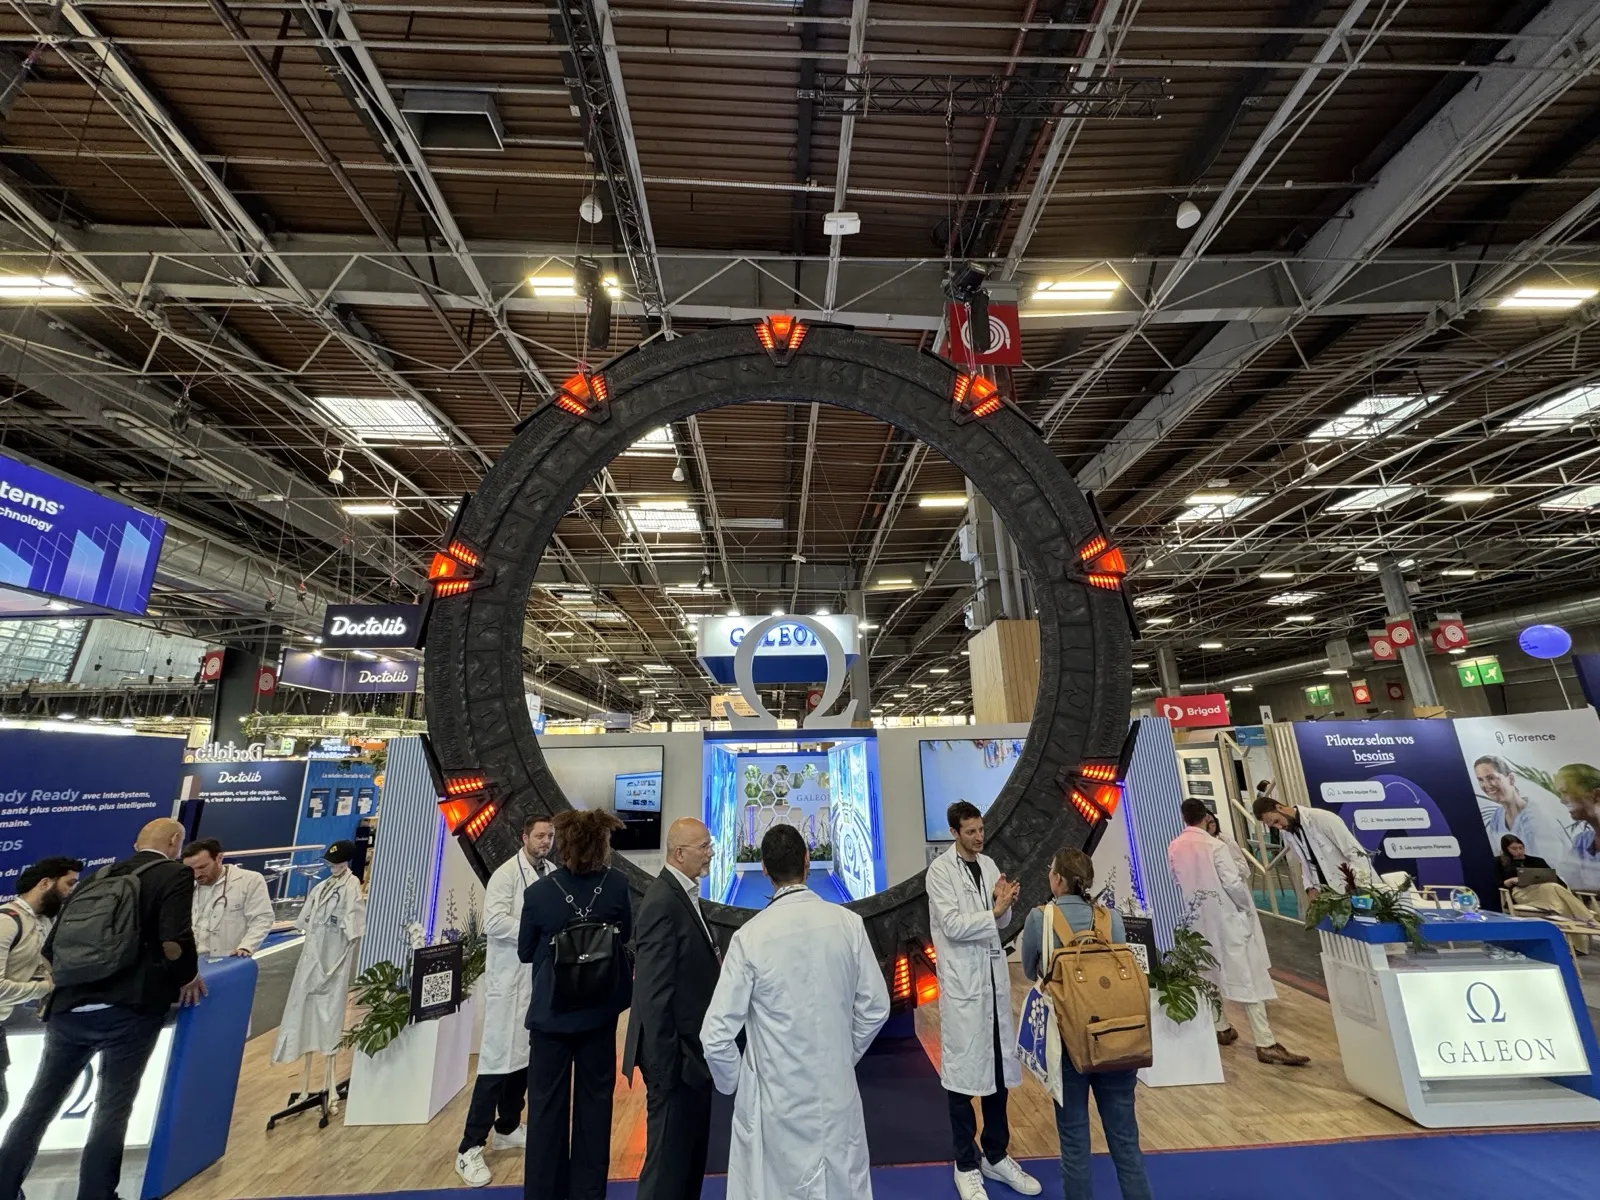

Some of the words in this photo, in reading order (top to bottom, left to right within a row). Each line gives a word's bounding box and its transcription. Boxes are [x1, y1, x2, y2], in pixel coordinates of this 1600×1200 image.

[331, 616, 407, 636] Doctolib
[730, 627, 818, 647] GLEO
[359, 670, 409, 684] Doctolib
[1186, 705, 1221, 717] Brigad
[1263, 711, 1271, 720] A
[1325, 733, 1365, 746] Pilotez
[1365, 732, 1395, 746] selon
[1395, 736, 1415, 745] vos
[1508, 732, 1556, 743] Florence
[1352, 749, 1395, 762] besoins
[218, 770, 262, 784] Doctolib
[30, 788, 80, 802] Ready
[102, 791, 151, 799] InterSystems,
[796, 793, 830, 803] GALEO
[1, 806, 29, 816] santé
[29, 805, 50, 816] plus
[51, 803, 97, 813] connectée,
[98, 803, 116, 812] plus
[116, 801, 157, 810] intelligente
[87, 856, 116, 867] patient
[5, 868, 18, 877] du
[1437, 1038, 1557, 1064] GALEON
